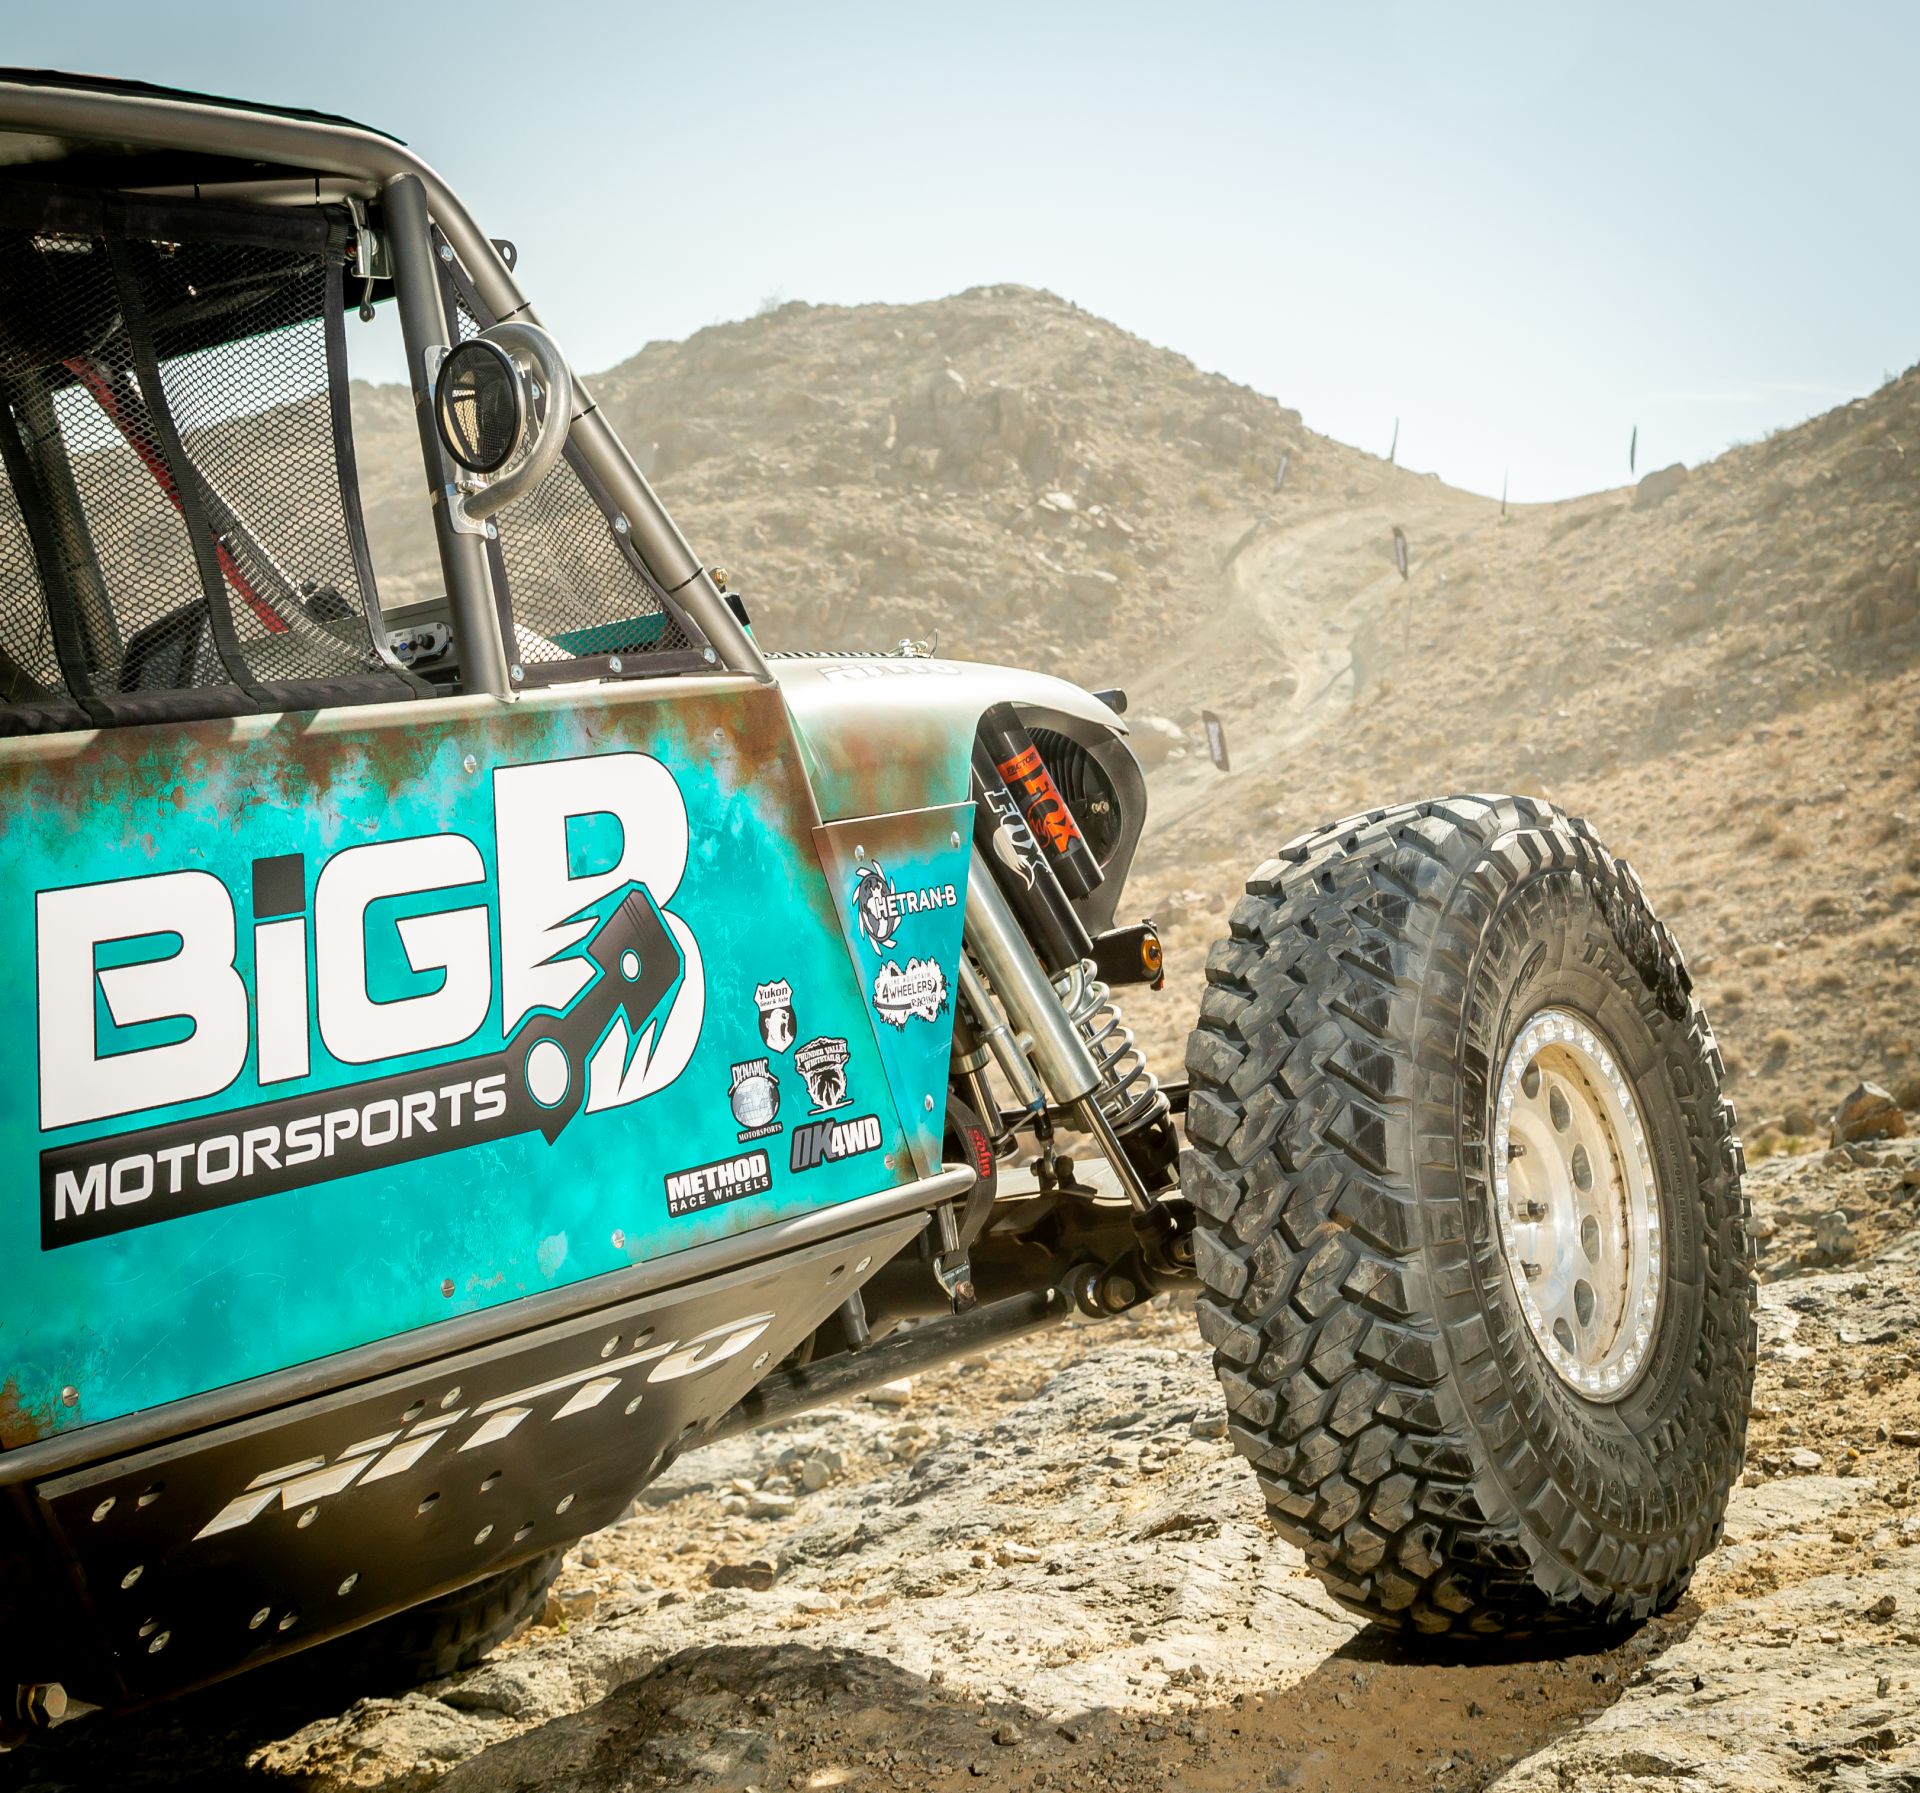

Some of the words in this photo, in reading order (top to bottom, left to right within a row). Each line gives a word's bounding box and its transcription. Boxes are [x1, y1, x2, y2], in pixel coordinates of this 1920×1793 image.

[1024, 768, 1082, 853] FOX
[875, 884, 958, 920] HETRAN-B
[758, 986, 788, 1000] Yukon
[759, 1000, 772, 1008] Gear
[910, 993, 937, 1008] RACING
[1582, 931, 1665, 1043] TRAIL
[795, 1048, 825, 1064] THUNDER
[824, 1043, 847, 1055] VALLEY
[803, 1053, 840, 1072] WHITETAILS
[731, 1059, 769, 1087] DYNAMIC
[54, 1073, 507, 1222] MOTORSPORTS
[738, 1122, 783, 1142] MOTORSPORTS
[791, 1116, 882, 1171] OK4WD
[667, 1154, 768, 1201] METHOD
[670, 1195, 707, 1213] RACE
[713, 1176, 769, 1201] WHEELS
[1664, 1052, 1721, 1383] GRAPPLER
